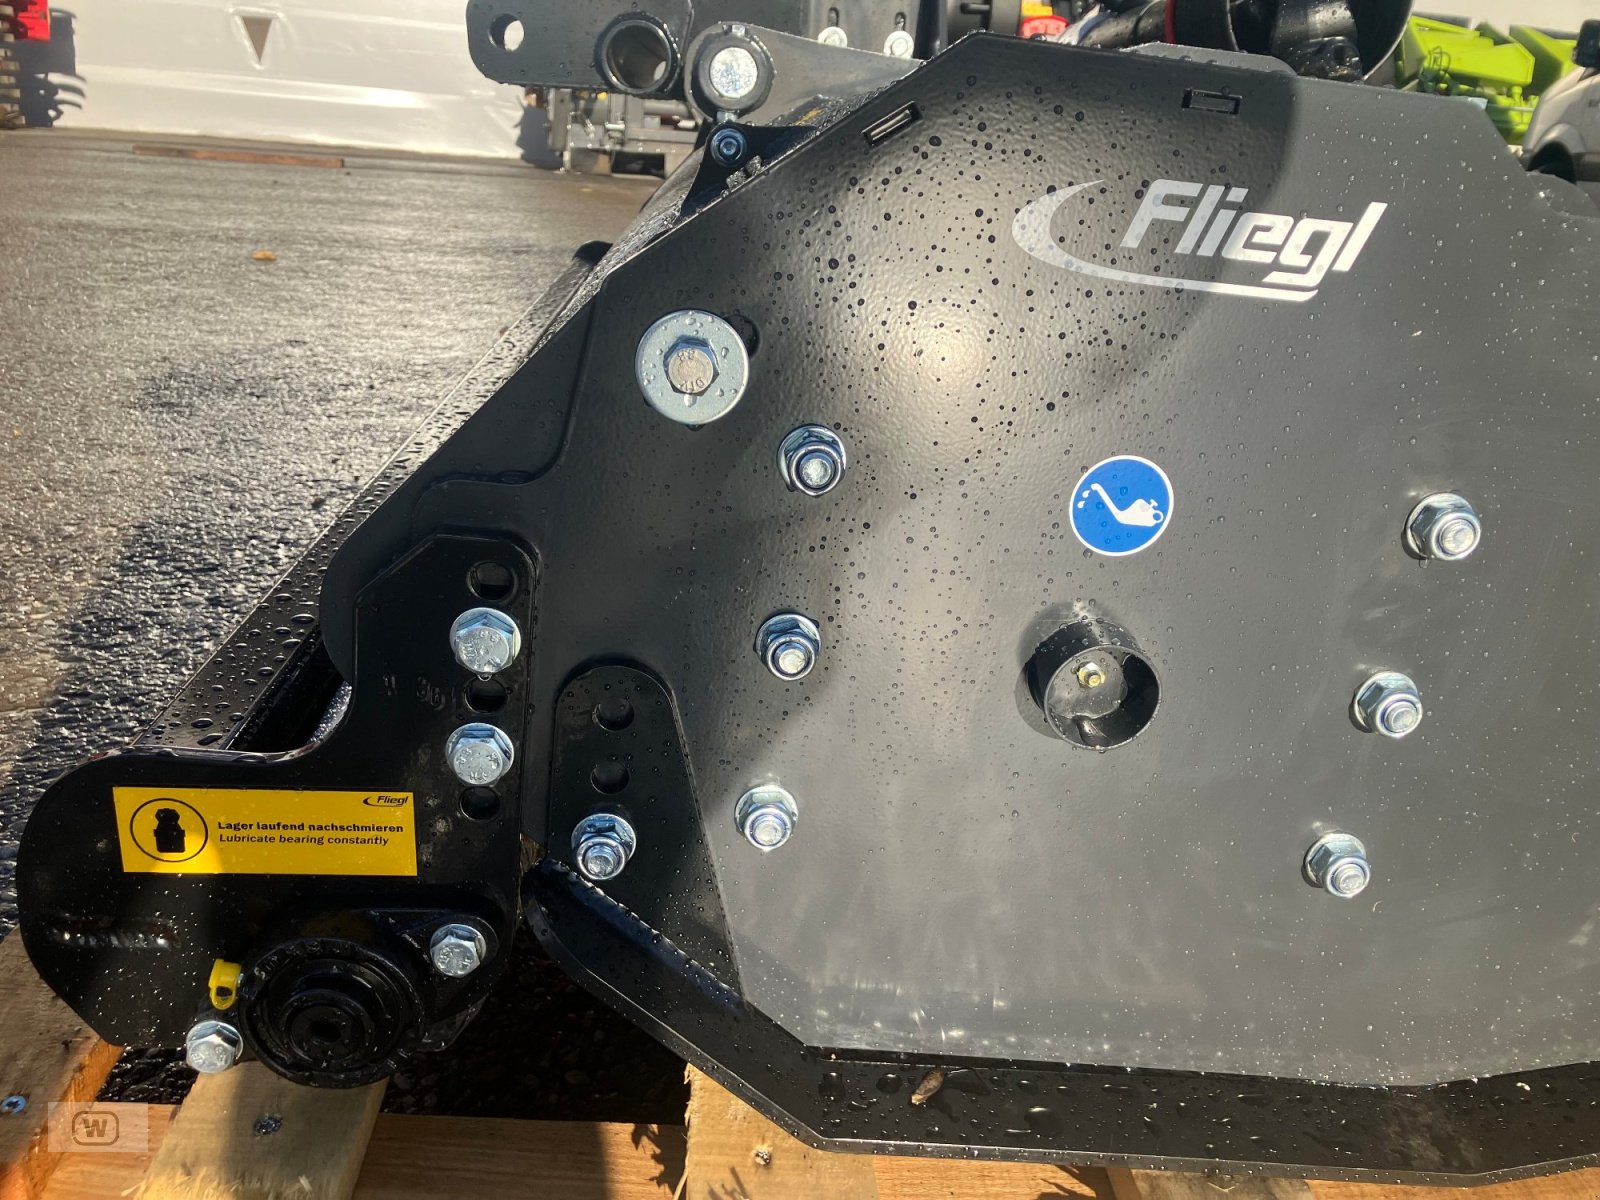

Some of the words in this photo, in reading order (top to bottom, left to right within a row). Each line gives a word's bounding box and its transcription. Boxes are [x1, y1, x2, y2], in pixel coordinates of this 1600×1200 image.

[1119, 178, 1389, 287] Fliegl
[376, 795, 409, 806] Fliegl
[218, 821, 253, 833] Lager
[257, 821, 305, 832] laufend
[308, 823, 404, 833] nachschmieren
[219, 834, 276, 843] Lubricate
[279, 835, 325, 845] bearing
[327, 836, 390, 847] constantly
